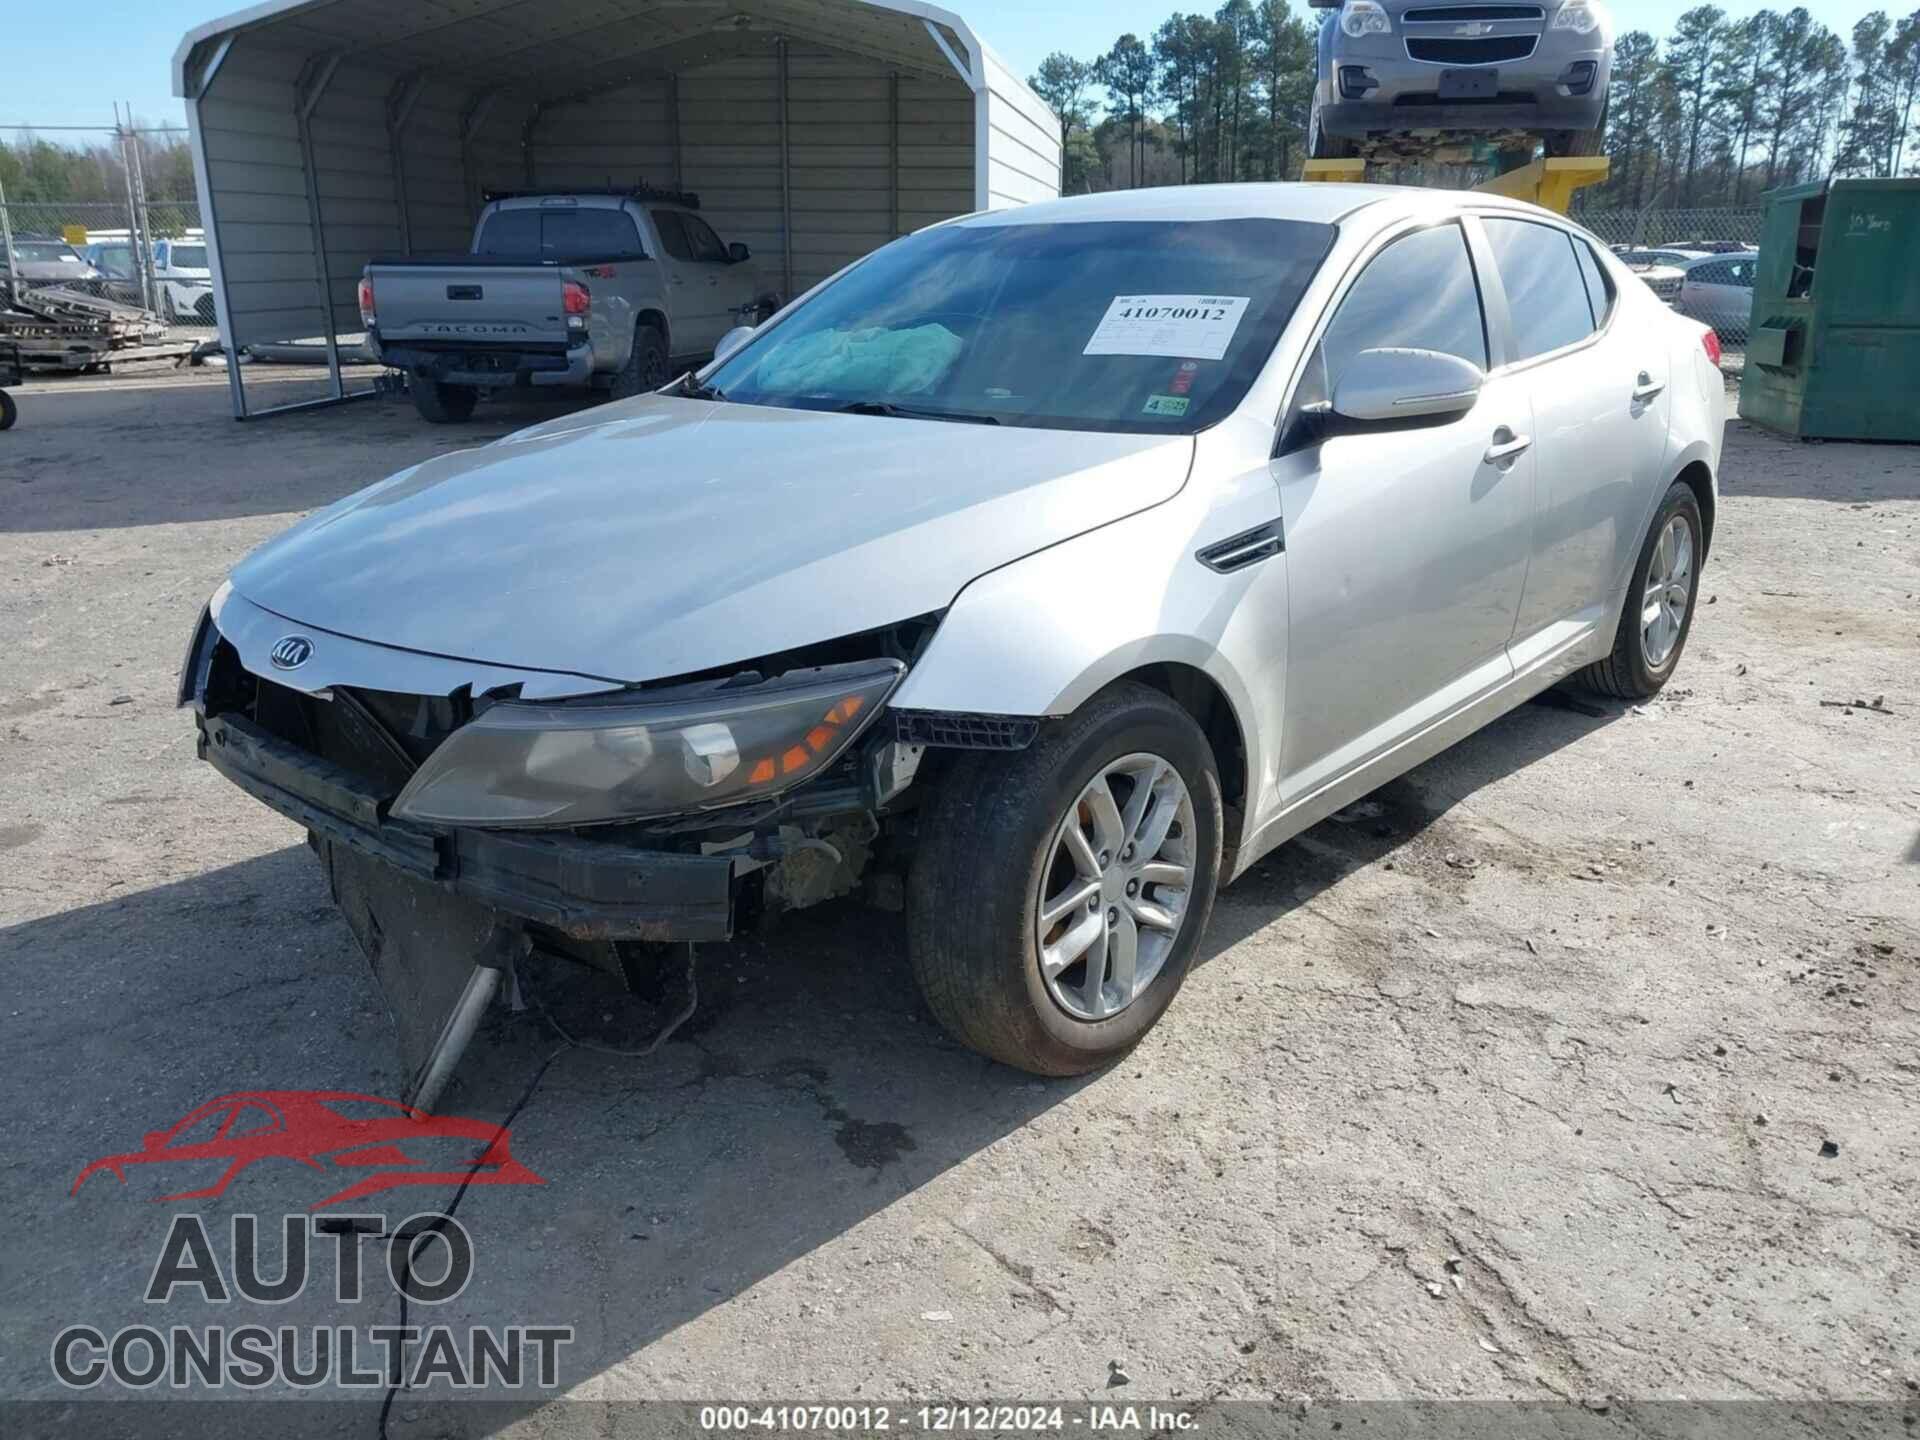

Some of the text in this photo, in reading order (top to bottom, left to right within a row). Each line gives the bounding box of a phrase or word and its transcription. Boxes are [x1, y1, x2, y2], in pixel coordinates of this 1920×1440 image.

[1119, 307, 1225, 321] 41070012
[422, 324, 528, 335] TACOMA
[1147, 399, 1161, 410] 4
[271, 639, 306, 665] KIA
